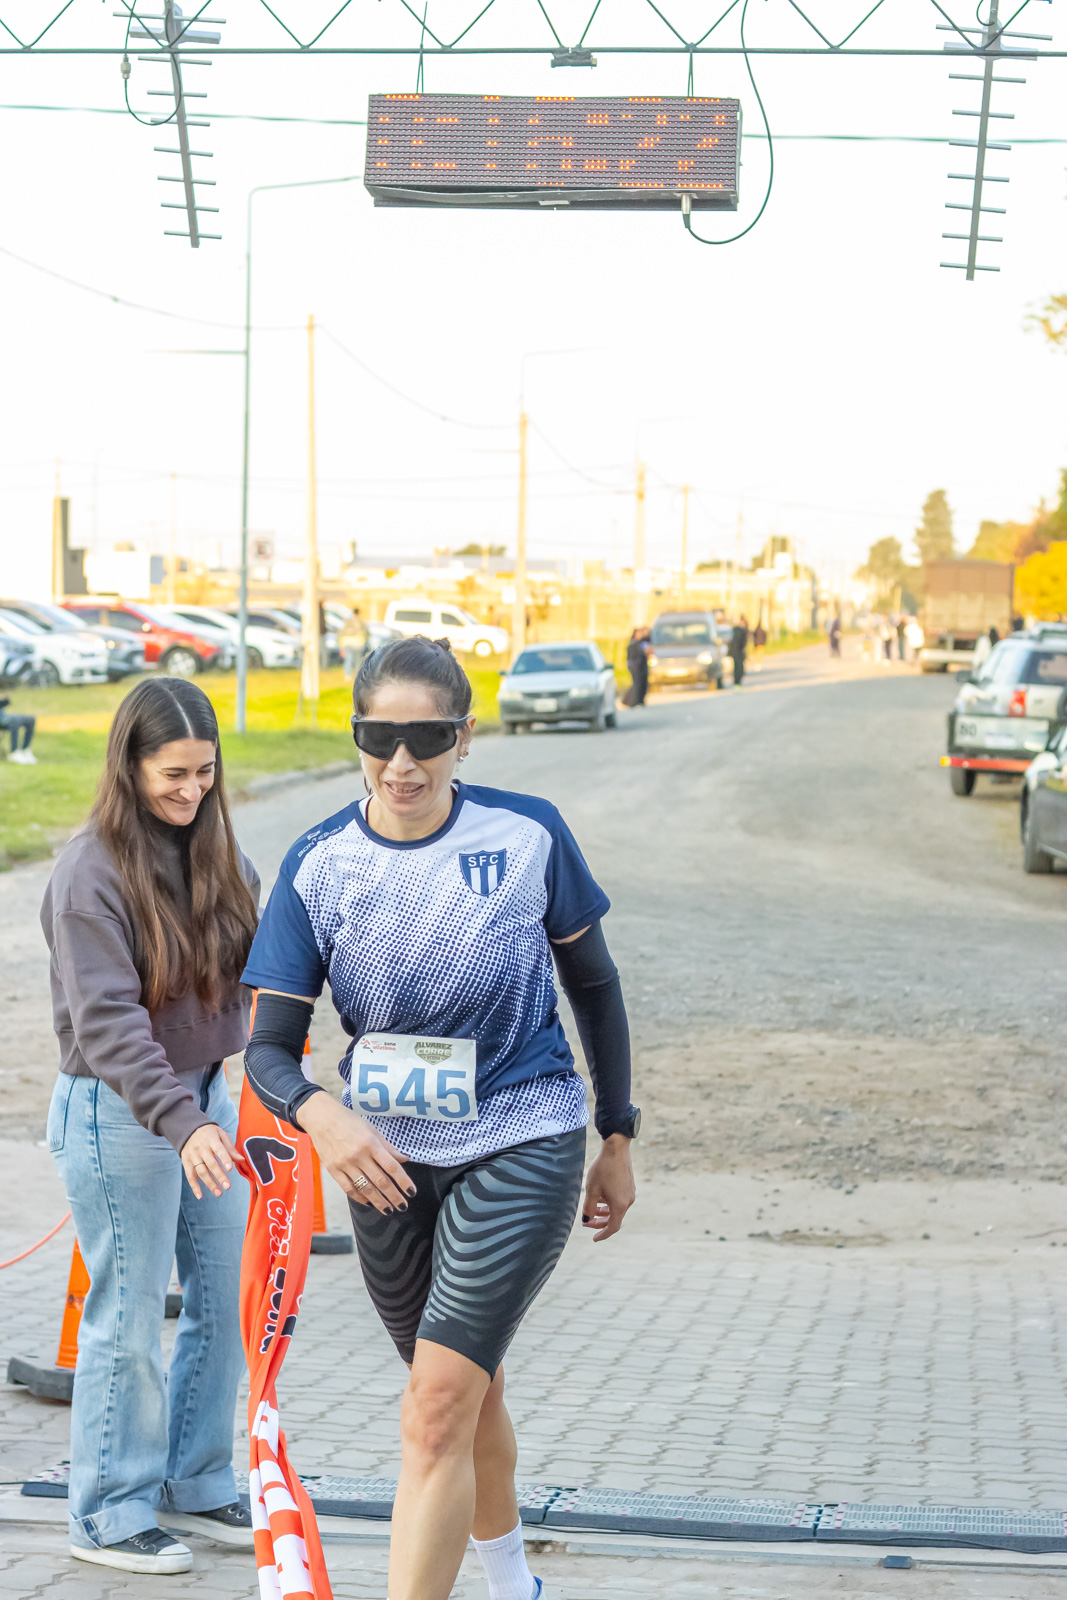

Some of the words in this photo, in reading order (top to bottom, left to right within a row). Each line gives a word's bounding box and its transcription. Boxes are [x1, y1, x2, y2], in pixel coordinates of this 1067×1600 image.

[467, 854, 499, 867] SFC
[414, 1041, 453, 1050] ALVAREZ
[416, 1047, 452, 1057] CORRE
[357, 1063, 471, 1119] 545
